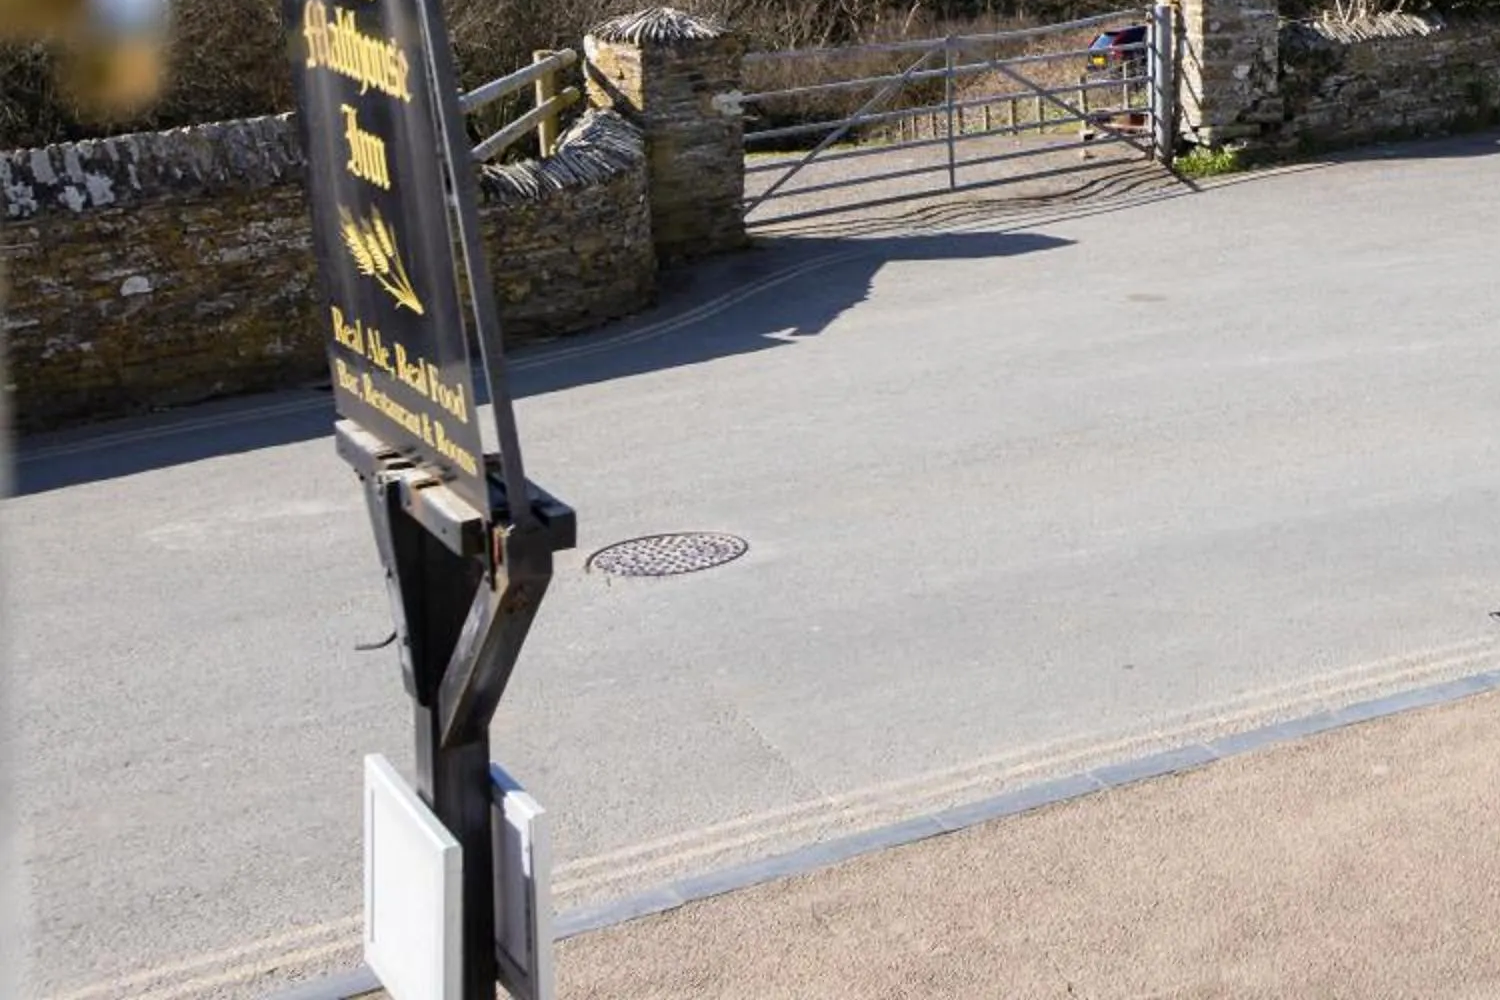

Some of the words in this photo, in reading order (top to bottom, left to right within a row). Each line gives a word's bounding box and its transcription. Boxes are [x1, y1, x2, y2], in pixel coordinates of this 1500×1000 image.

[341, 103, 391, 190] Inn
[331, 305, 364, 354] Real
[394, 342, 428, 396] Real
[427, 363, 468, 424] Food
